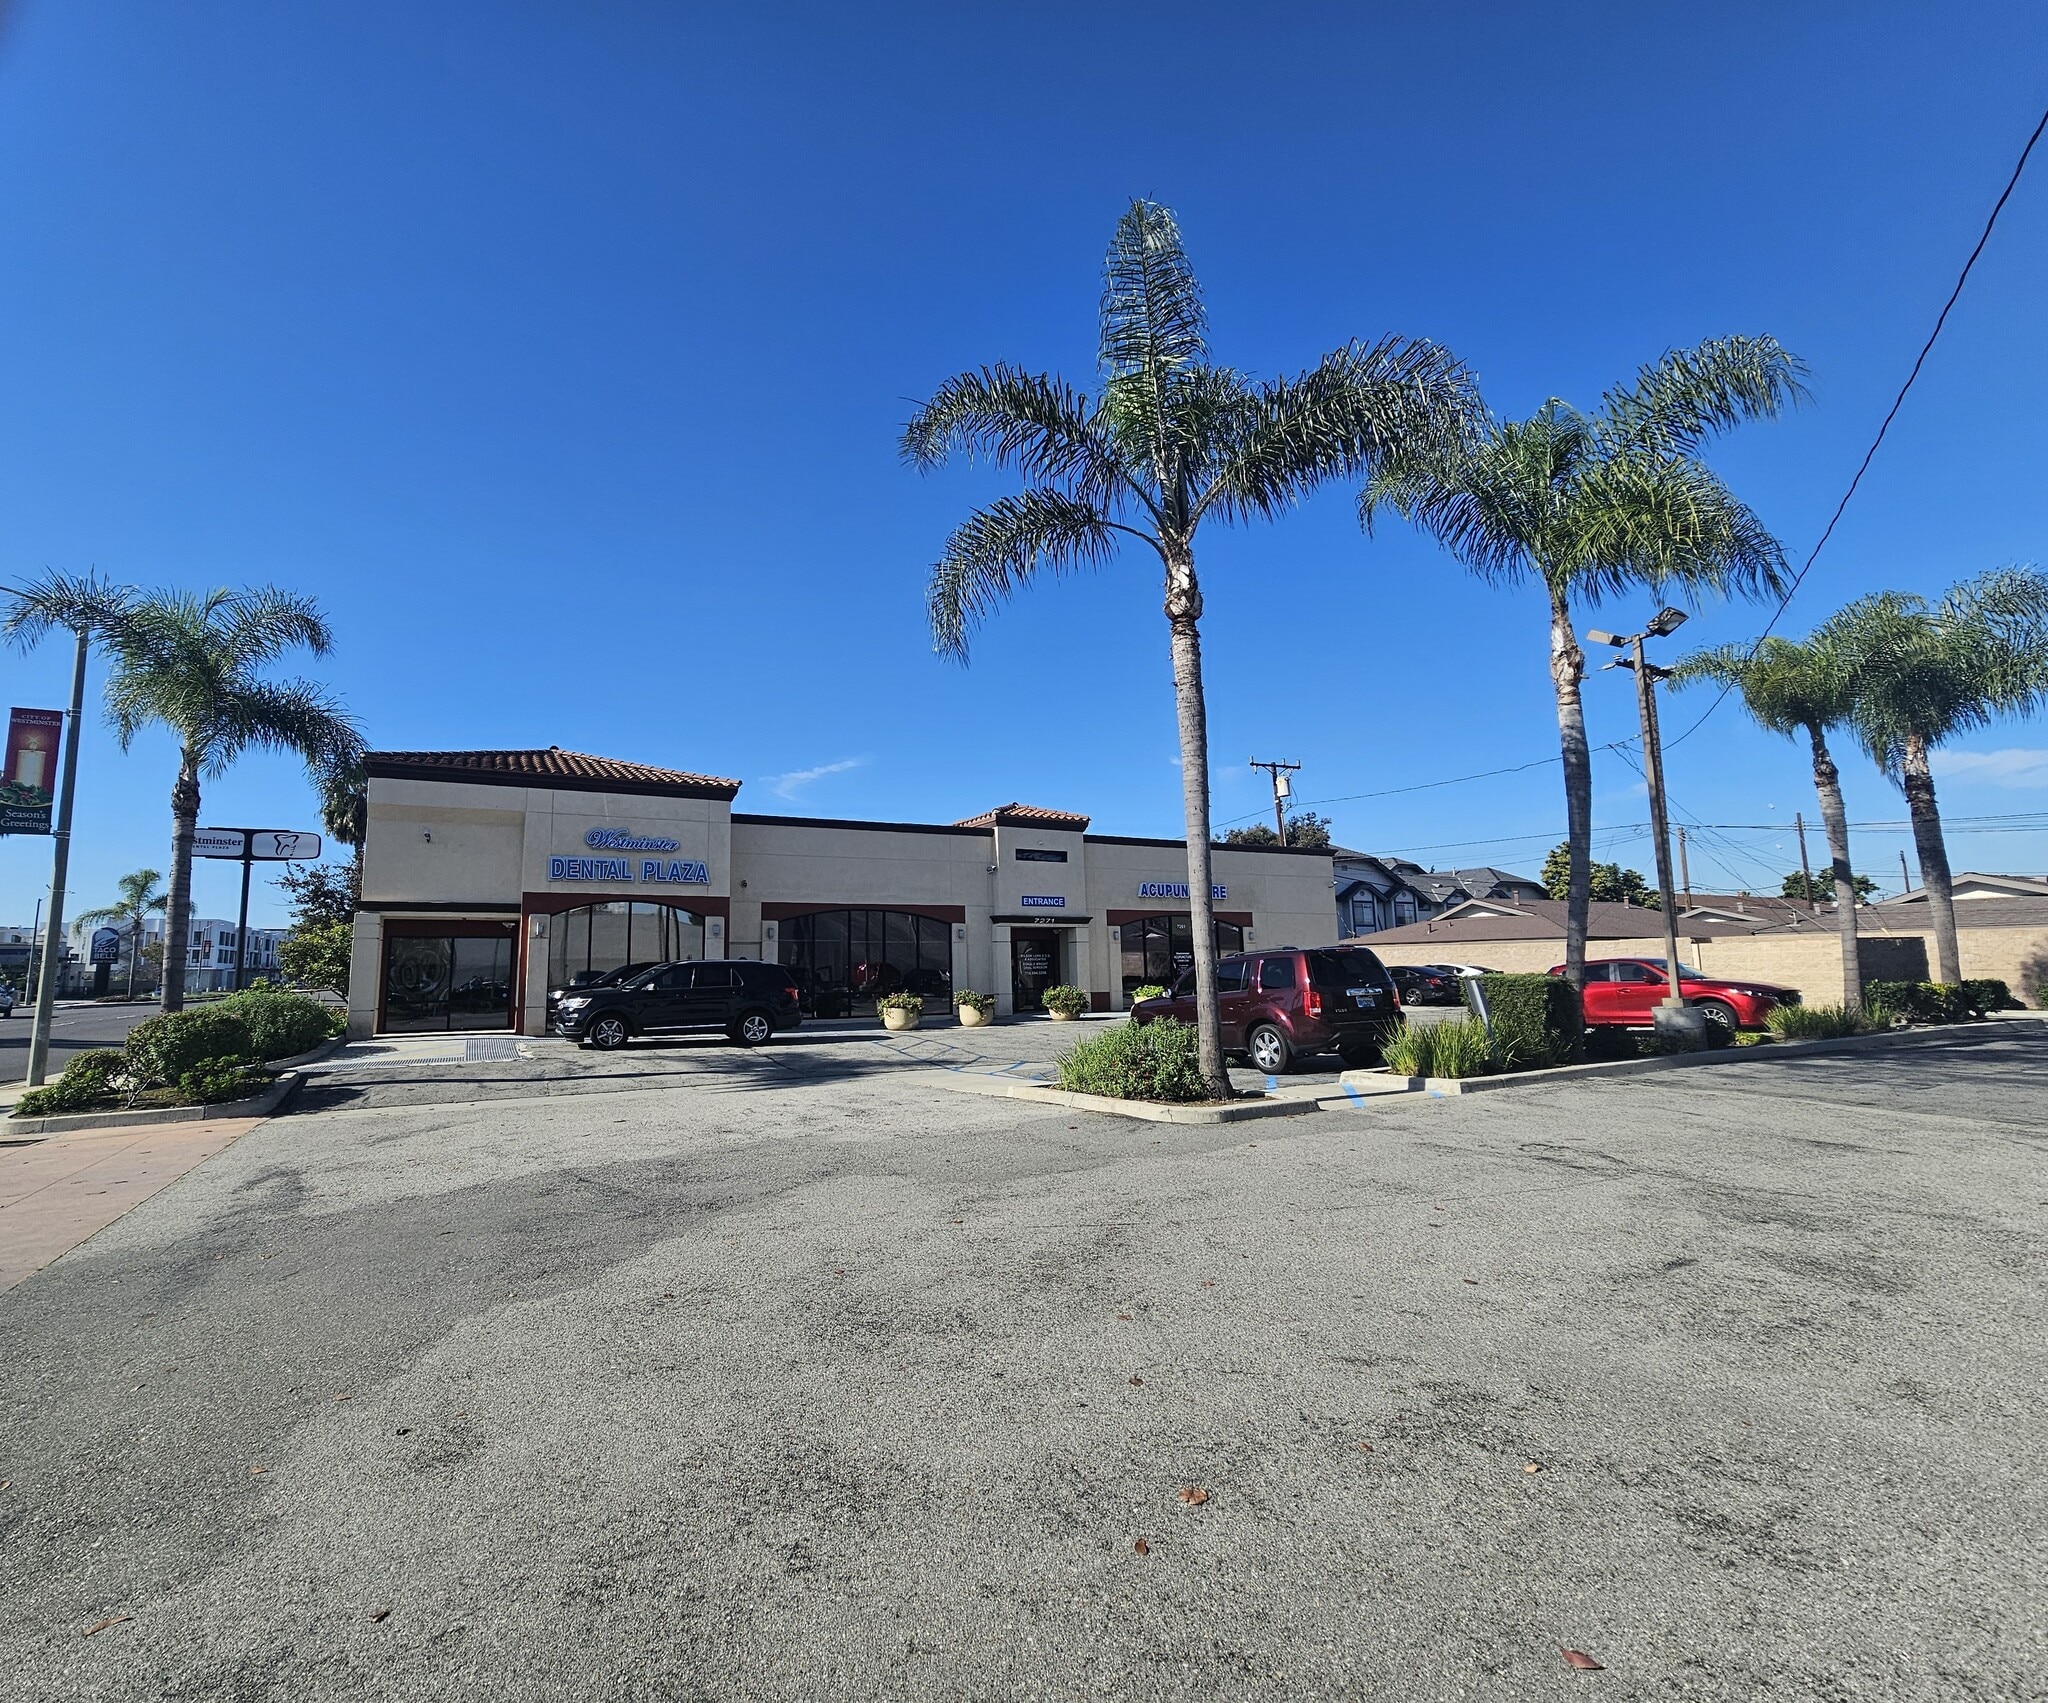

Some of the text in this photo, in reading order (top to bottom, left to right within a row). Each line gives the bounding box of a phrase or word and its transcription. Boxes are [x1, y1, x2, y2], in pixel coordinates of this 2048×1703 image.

[11, 718, 61, 727] WESTMINSTER
[5, 809, 46, 819] Season's
[0, 818, 49, 831] Greetings
[193, 837, 243, 846] stminster
[586, 828, 681, 851] Westminster
[549, 856, 710, 884] DENTAL PLAZA
[1139, 882, 1227, 899] ACUPUNRE
[1023, 897, 1064, 906] ENTRANCE
